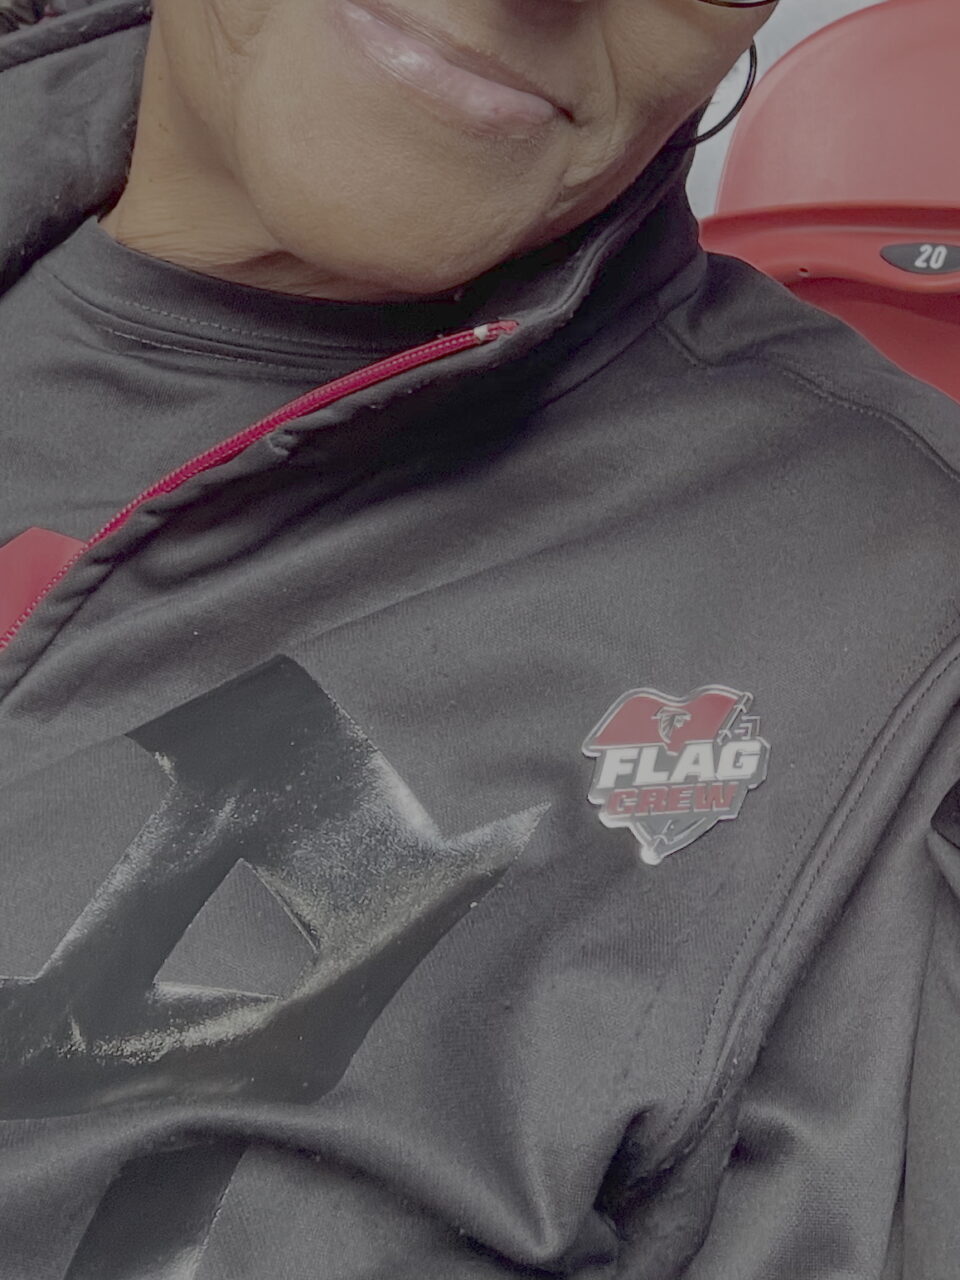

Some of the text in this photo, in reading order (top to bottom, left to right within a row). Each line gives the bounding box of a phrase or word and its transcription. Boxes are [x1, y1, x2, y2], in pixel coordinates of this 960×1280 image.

[914, 244, 948, 269] 20
[596, 740, 762, 789] FLAG
[606, 781, 740, 817] CREW
